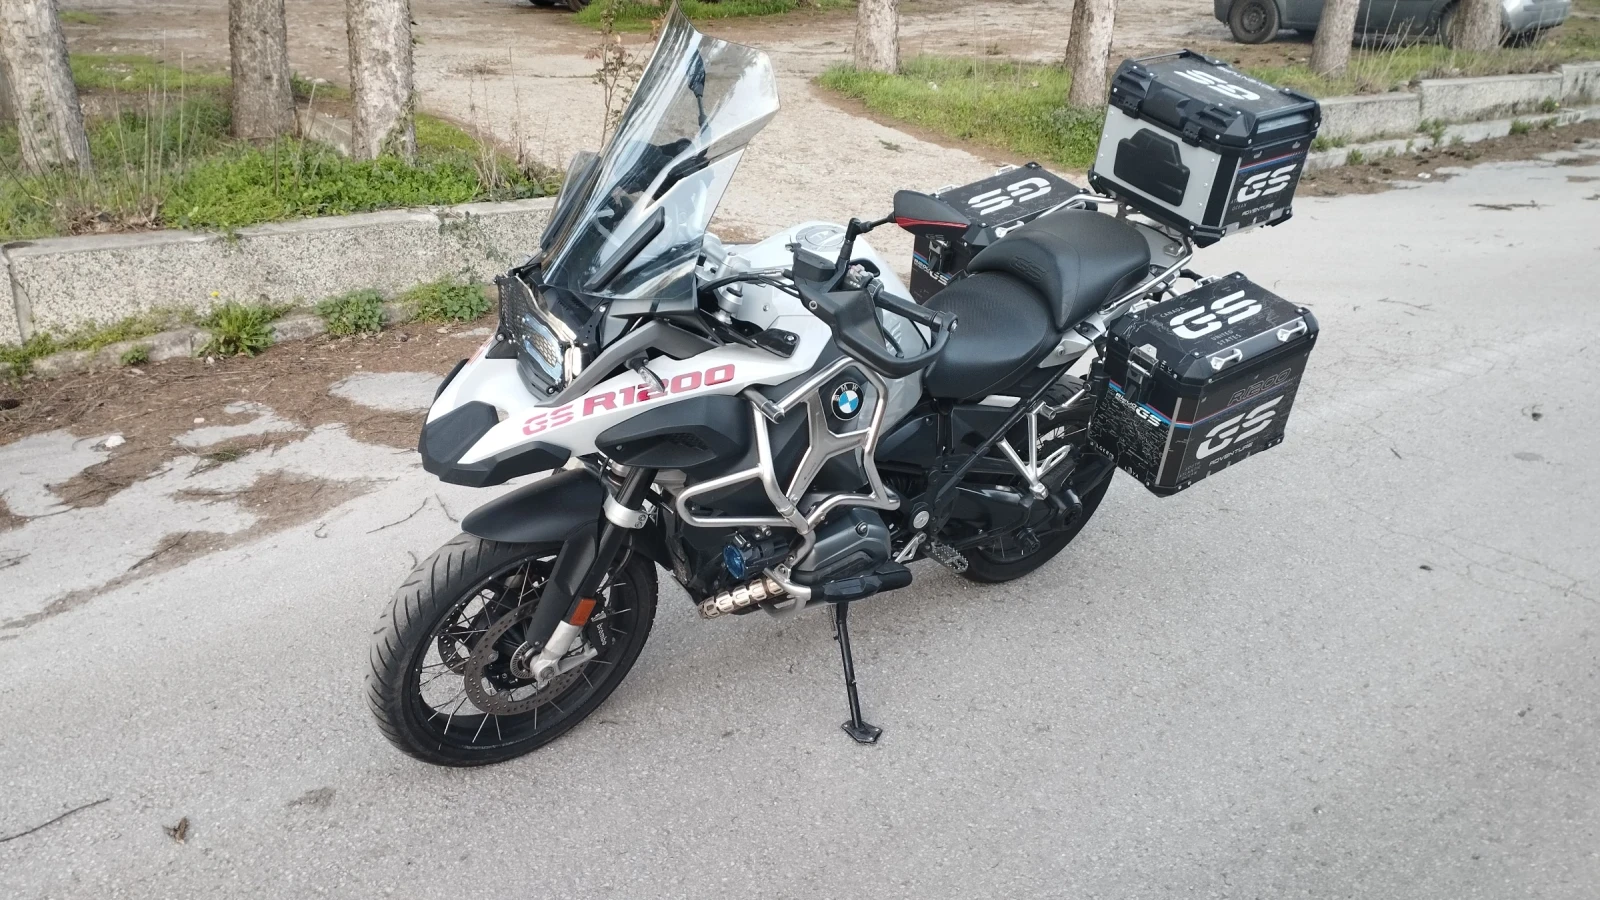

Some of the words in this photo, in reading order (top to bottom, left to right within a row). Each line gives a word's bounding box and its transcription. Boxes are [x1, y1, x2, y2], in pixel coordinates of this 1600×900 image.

[1173, 69, 1261, 100] GS
[967, 177, 1052, 216] GS
[1237, 164, 1297, 203] GS
[1160, 306, 1186, 318] CANADA
[1169, 290, 1262, 339] GS
[1210, 329, 1235, 341] UNITED
[1216, 333, 1242, 346] STATES
[522, 405, 574, 436] GS
[583, 363, 736, 417] R1200
[834, 383, 859, 402] BMW
[1226, 367, 1292, 407] R1200
[1135, 406, 1162, 427] GS
[1195, 395, 1285, 460] GS
[1208, 441, 1254, 467] ADVENTURE
[596, 622, 608, 646] brembo
